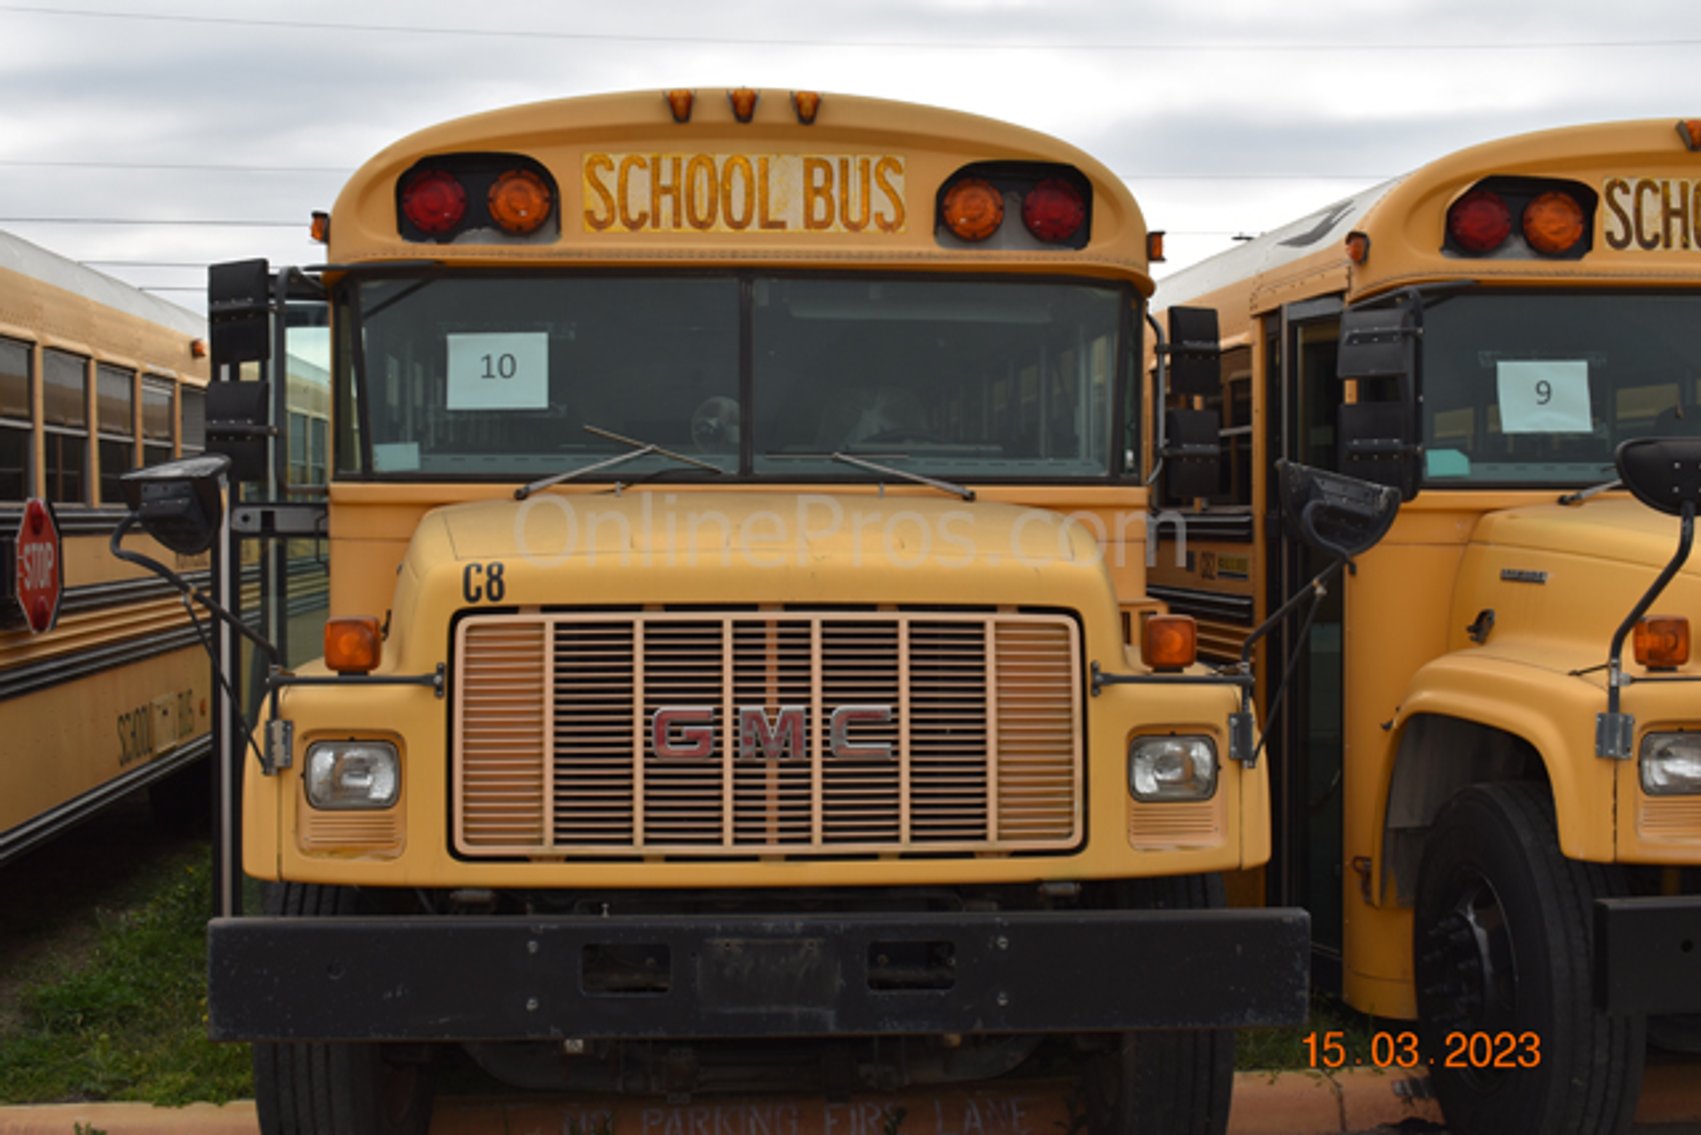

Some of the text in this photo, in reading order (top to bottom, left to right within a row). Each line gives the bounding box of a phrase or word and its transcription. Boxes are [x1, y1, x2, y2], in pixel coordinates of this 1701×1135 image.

[584, 154, 905, 233] SCHOOL BUS
[481, 353, 517, 379] 10
[1535, 380, 1551, 405] 9
[24, 542, 54, 590] STOP
[463, 562, 505, 604] C8
[652, 705, 892, 759] GMC
[641, 1104, 801, 1135] PARKING
[933, 1095, 1026, 1135] LANE
